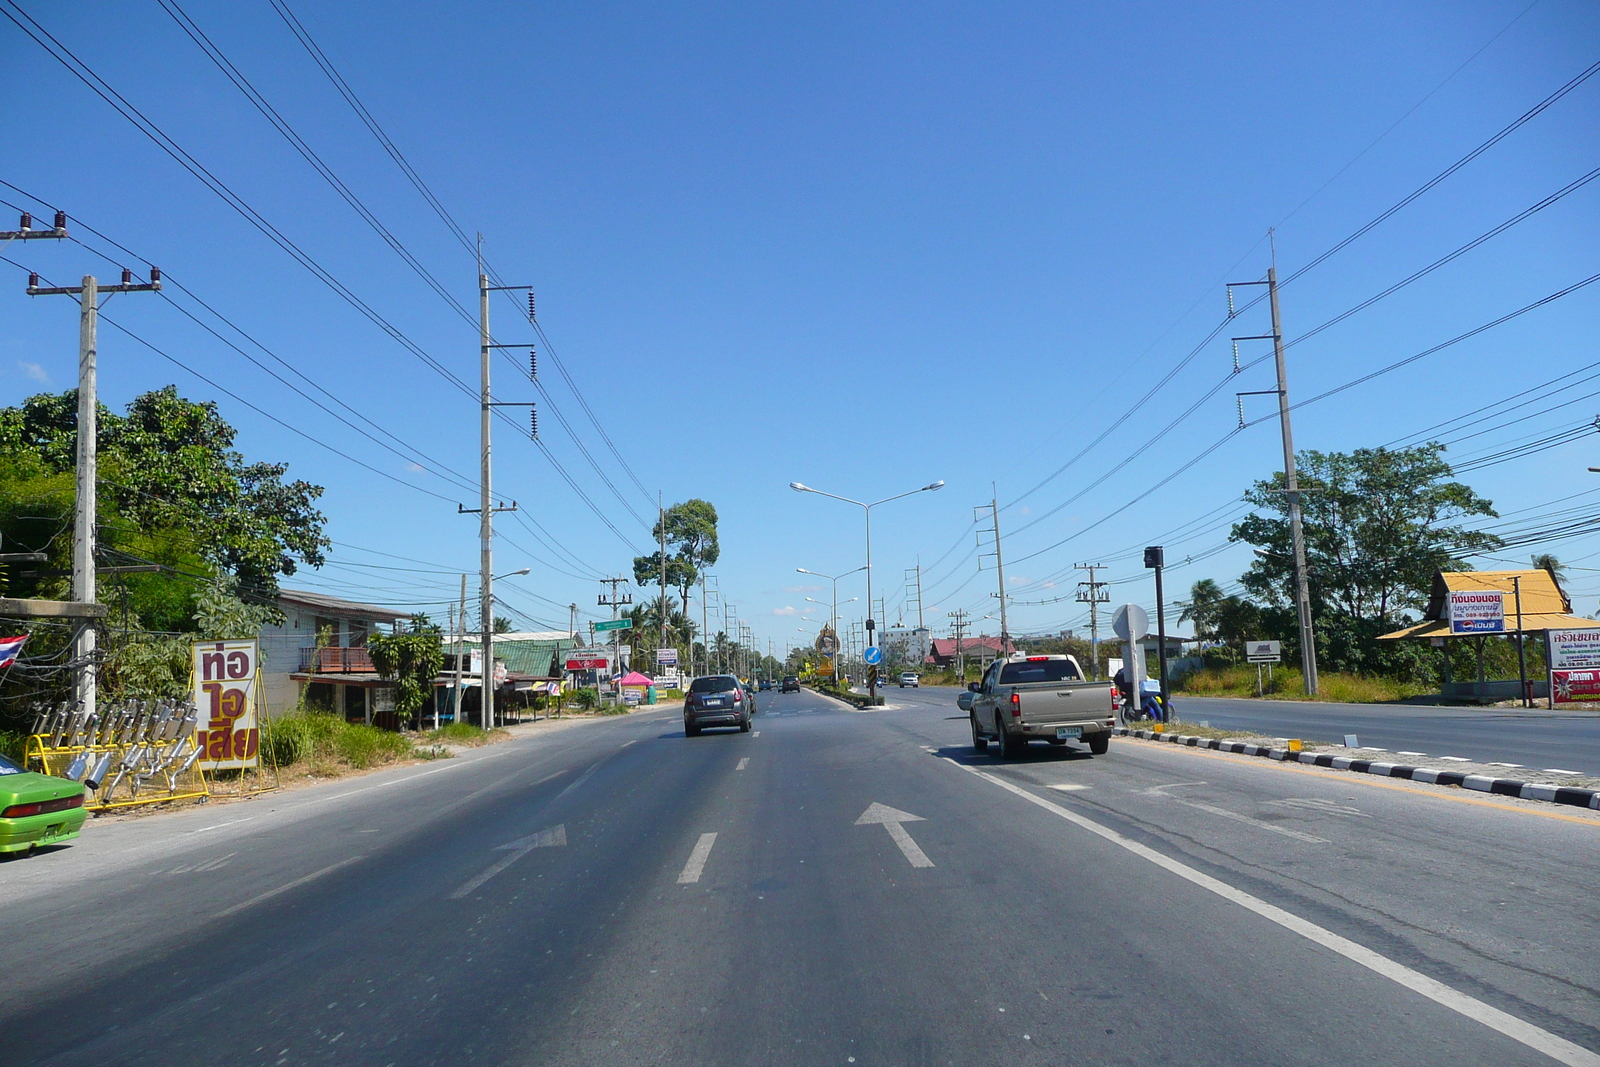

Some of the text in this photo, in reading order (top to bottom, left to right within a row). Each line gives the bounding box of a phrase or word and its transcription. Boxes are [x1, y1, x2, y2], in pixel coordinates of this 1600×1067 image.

[202, 643, 249, 680] ท่อ
[202, 683, 246, 721] ไอ
[197, 717, 258, 762] เสีย
